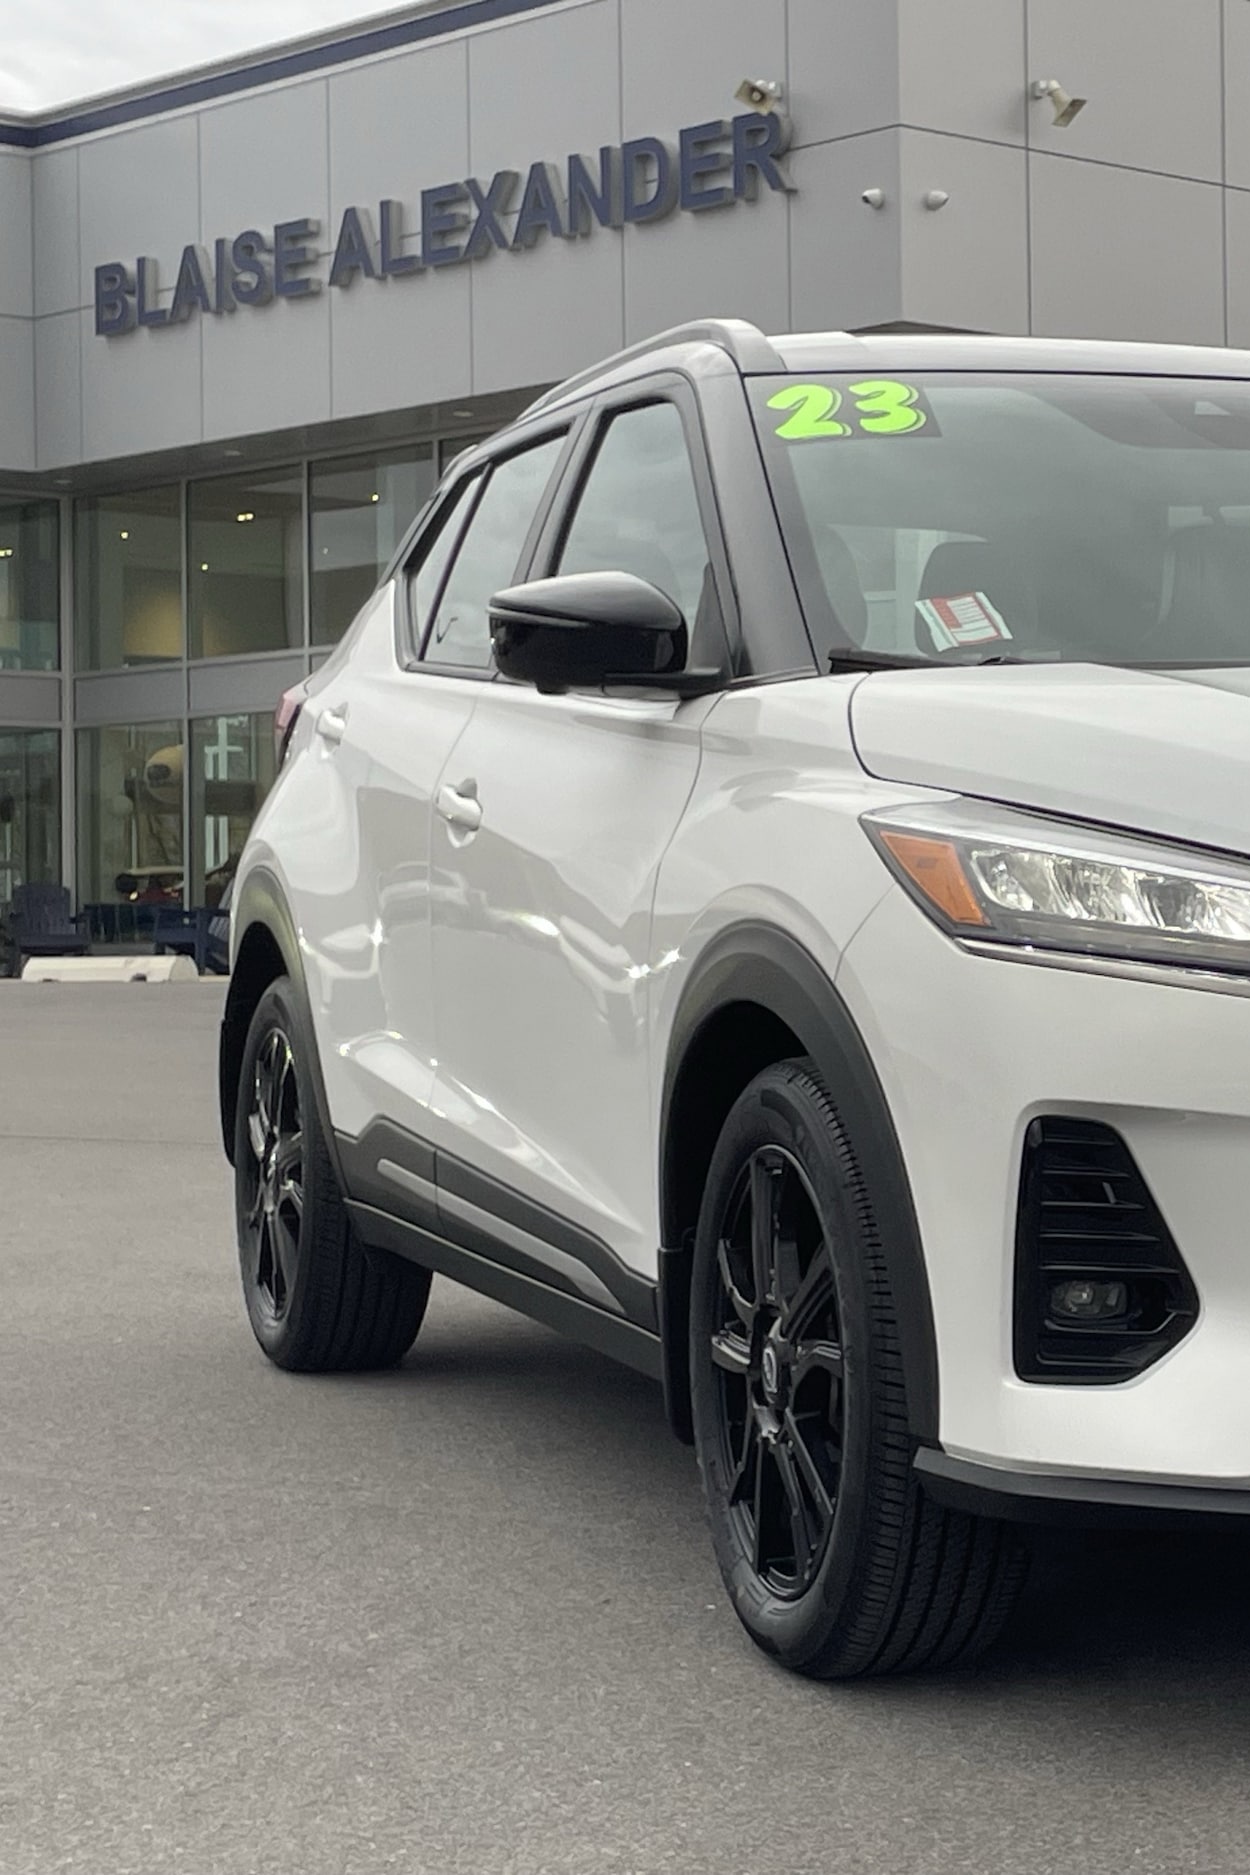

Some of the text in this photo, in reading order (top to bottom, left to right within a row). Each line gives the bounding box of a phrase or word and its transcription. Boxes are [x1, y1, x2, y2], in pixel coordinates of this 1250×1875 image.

[95, 111, 796, 336] BLAISE ALEXANDER
[766, 380, 927, 440] 23
